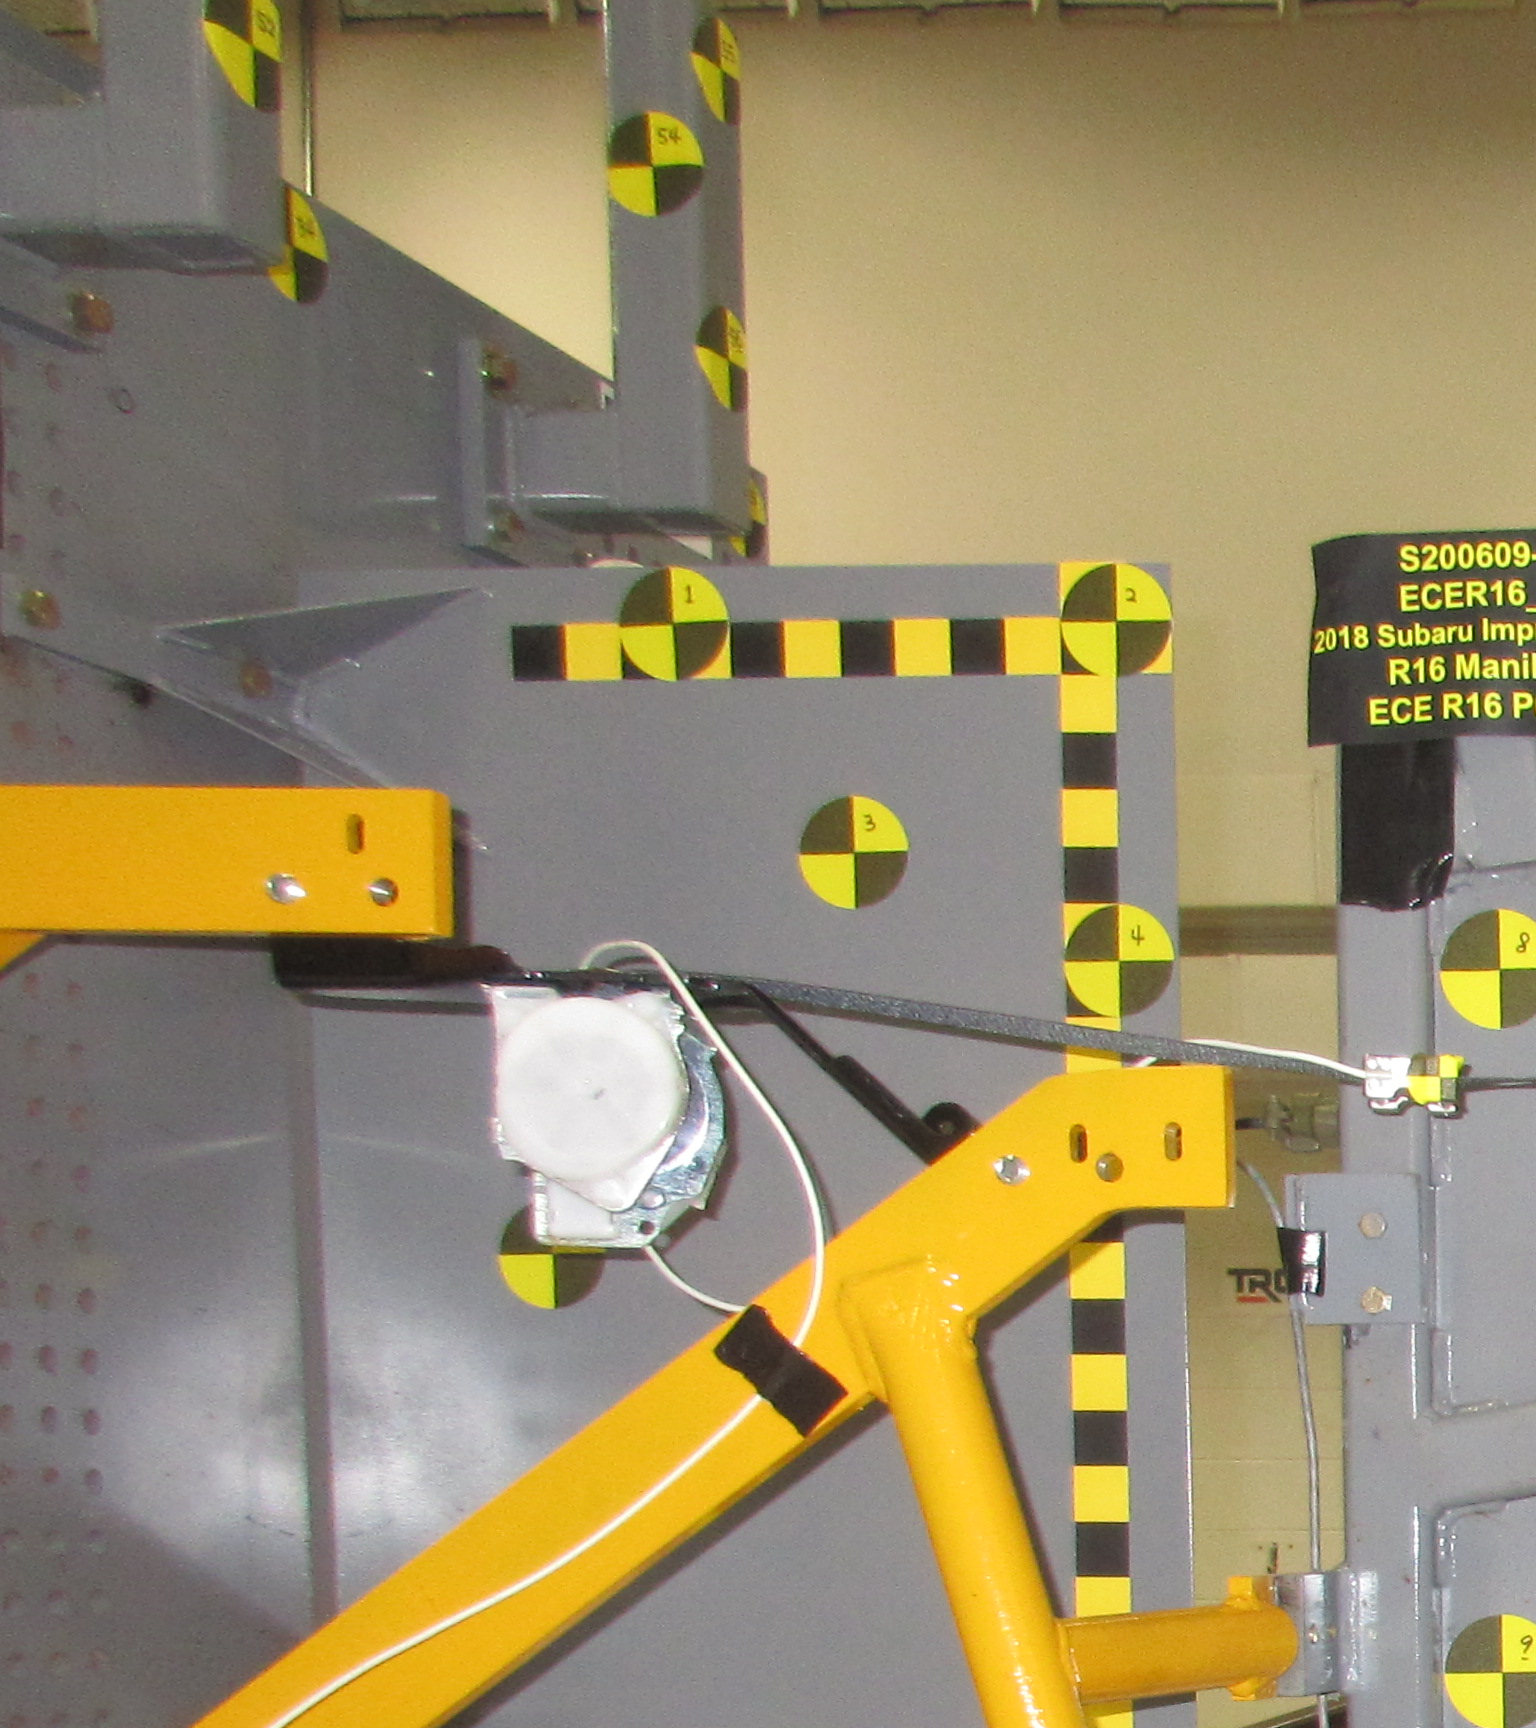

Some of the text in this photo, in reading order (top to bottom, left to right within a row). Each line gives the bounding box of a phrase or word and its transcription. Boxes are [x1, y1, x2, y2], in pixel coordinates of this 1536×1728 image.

[657, 127, 682, 145] 54
[685, 584, 694, 604] 1
[1125, 587, 1137, 603] 2
[1314, 626, 1370, 654] 2018
[1378, 622, 1473, 649] Subaru
[1388, 656, 1447, 686] R16
[1369, 696, 1433, 726] ECE
[1443, 692, 1504, 721] R16
[863, 814, 876, 832] 3
[1131, 925, 1145, 946] 4
[1516, 931, 1530, 953] 8
